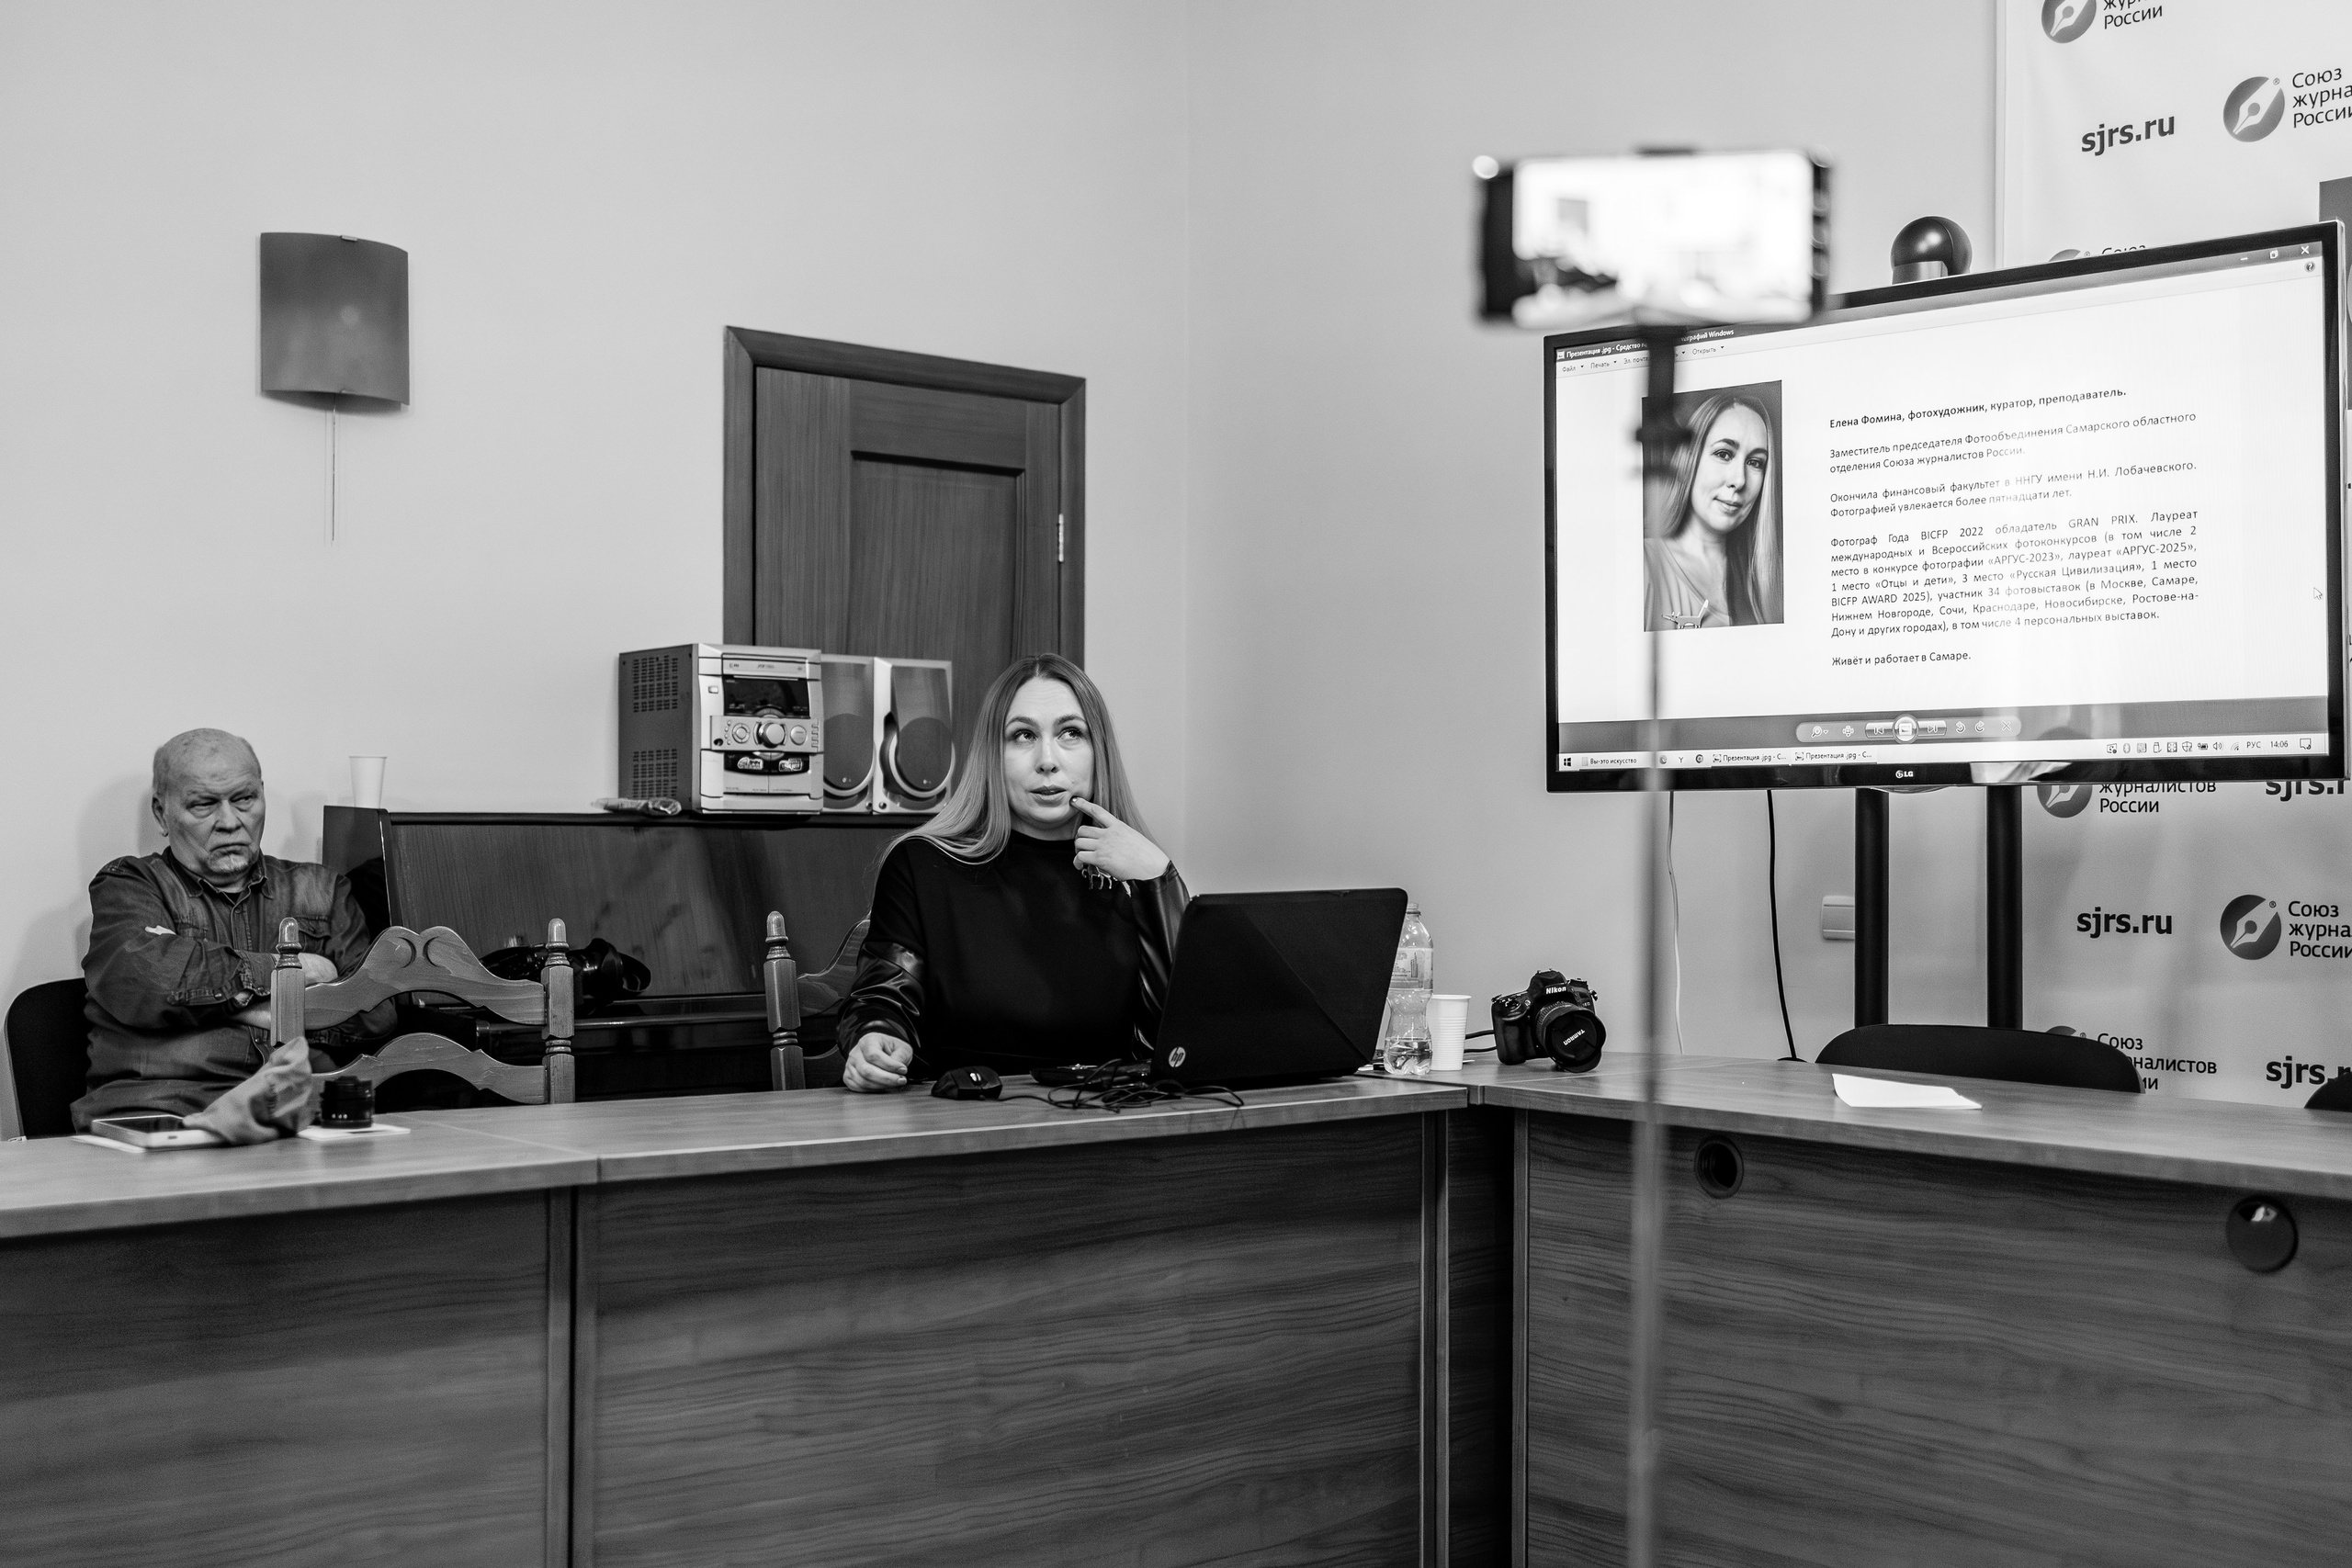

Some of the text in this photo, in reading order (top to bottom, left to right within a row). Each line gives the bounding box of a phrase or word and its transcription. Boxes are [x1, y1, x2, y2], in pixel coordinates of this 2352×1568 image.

[2104, 6, 2163, 29] России
[2292, 68, 2342, 88] Союз
[2081, 116, 2175, 156] sjrs.ru
[1709, 329, 1735, 338] Windows
[1829, 388, 2126, 428] Елена Фомина, фотохудожник, куратор, преподаватель.
[1829, 413, 2196, 458] Заместитель председателя Фотообъединения Самарского областного
[1829, 447, 2025, 473] отделения Союза журналистов России.
[1829, 491, 1878, 502] Окончила
[1882, 483, 1945, 499] финансовый
[1950, 479, 1999, 493] факультет
[2015, 474, 2042, 484] ННГУ
[2047, 473, 2082, 482] имени
[2087, 468, 2109, 479] Н.И.
[2114, 462, 2196, 476] Лобачевского.
[1830, 490, 2072, 517] Фотографией увлекается более пятнадцати лет.
[1830, 511, 2198, 547] Фотограф Года BICFP 2022 обладатель GRAN PRIX. Лауреат
[1830, 549, 1912, 562] международных
[1931, 542, 2007, 555] Всероссийских
[2015, 535, 2097, 549] фотоконкурсов
[2104, 532, 2114, 543] (в
[2149, 528, 2182, 537] числе
[2190, 525, 2196, 535] 2
[1831, 568, 1860, 576] место
[1872, 563, 1918, 573] конкурсе
[1921, 558, 1984, 571] фотографии
[1988, 551, 2063, 565] «АРГУС-2023»,
[2067, 549, 2111, 560] лауреат
[2116, 541, 2197, 555] «АРГУС-2025»,
[1831, 582, 1837, 592] 1
[1841, 582, 1870, 591] место
[1875, 579, 1906, 589] «Отцы
[1923, 577, 1956, 586] дети»,
[1962, 573, 1968, 583] 3
[1973, 572, 2004, 581] место
[2009, 569, 2056, 580] «Русская
[2062, 564, 2144, 577] Цивилизация»,
[2152, 560, 2156, 570] 1
[2163, 559, 2197, 569] место
[1831, 576, 2198, 606] BICFP AWARD 2025), участник 34 фотовыставок (в Москве, Самаре,
[1831, 592, 2199, 621] Нижнем Новгороде, Сочи, Краснодаре, Новосибирске, Ростове-на-
[1830, 627, 1856, 638] Дону
[1867, 626, 1900, 636] других
[1903, 620, 1949, 634] городах),
[1951, 622, 1958, 630] в
[1960, 621, 1979, 629] том
[1982, 619, 2011, 627] числе
[2015, 617, 2020, 626] 4
[2024, 615, 2102, 626] персональных
[2105, 611, 2159, 621] выставок.
[1831, 656, 1862, 665] Живёт
[1874, 653, 1919, 666] работает
[1928, 651, 1971, 661] Самаре.
[1805, 751, 1845, 761] Презентация
[2246, 740, 2261, 750] РУС
[2270, 740, 2289, 749] 14:06
[1723, 754, 1760, 762] Презентация
[2098, 783, 2217, 797] журналистов
[2099, 797, 2159, 813] России
[2288, 900, 2339, 918] Союз
[2076, 907, 2173, 939] sjrs.ru
[2289, 923, 2352, 941] журна
[1545, 987, 1566, 995] Nikon
[1170, 1046, 1185, 1067] hp
